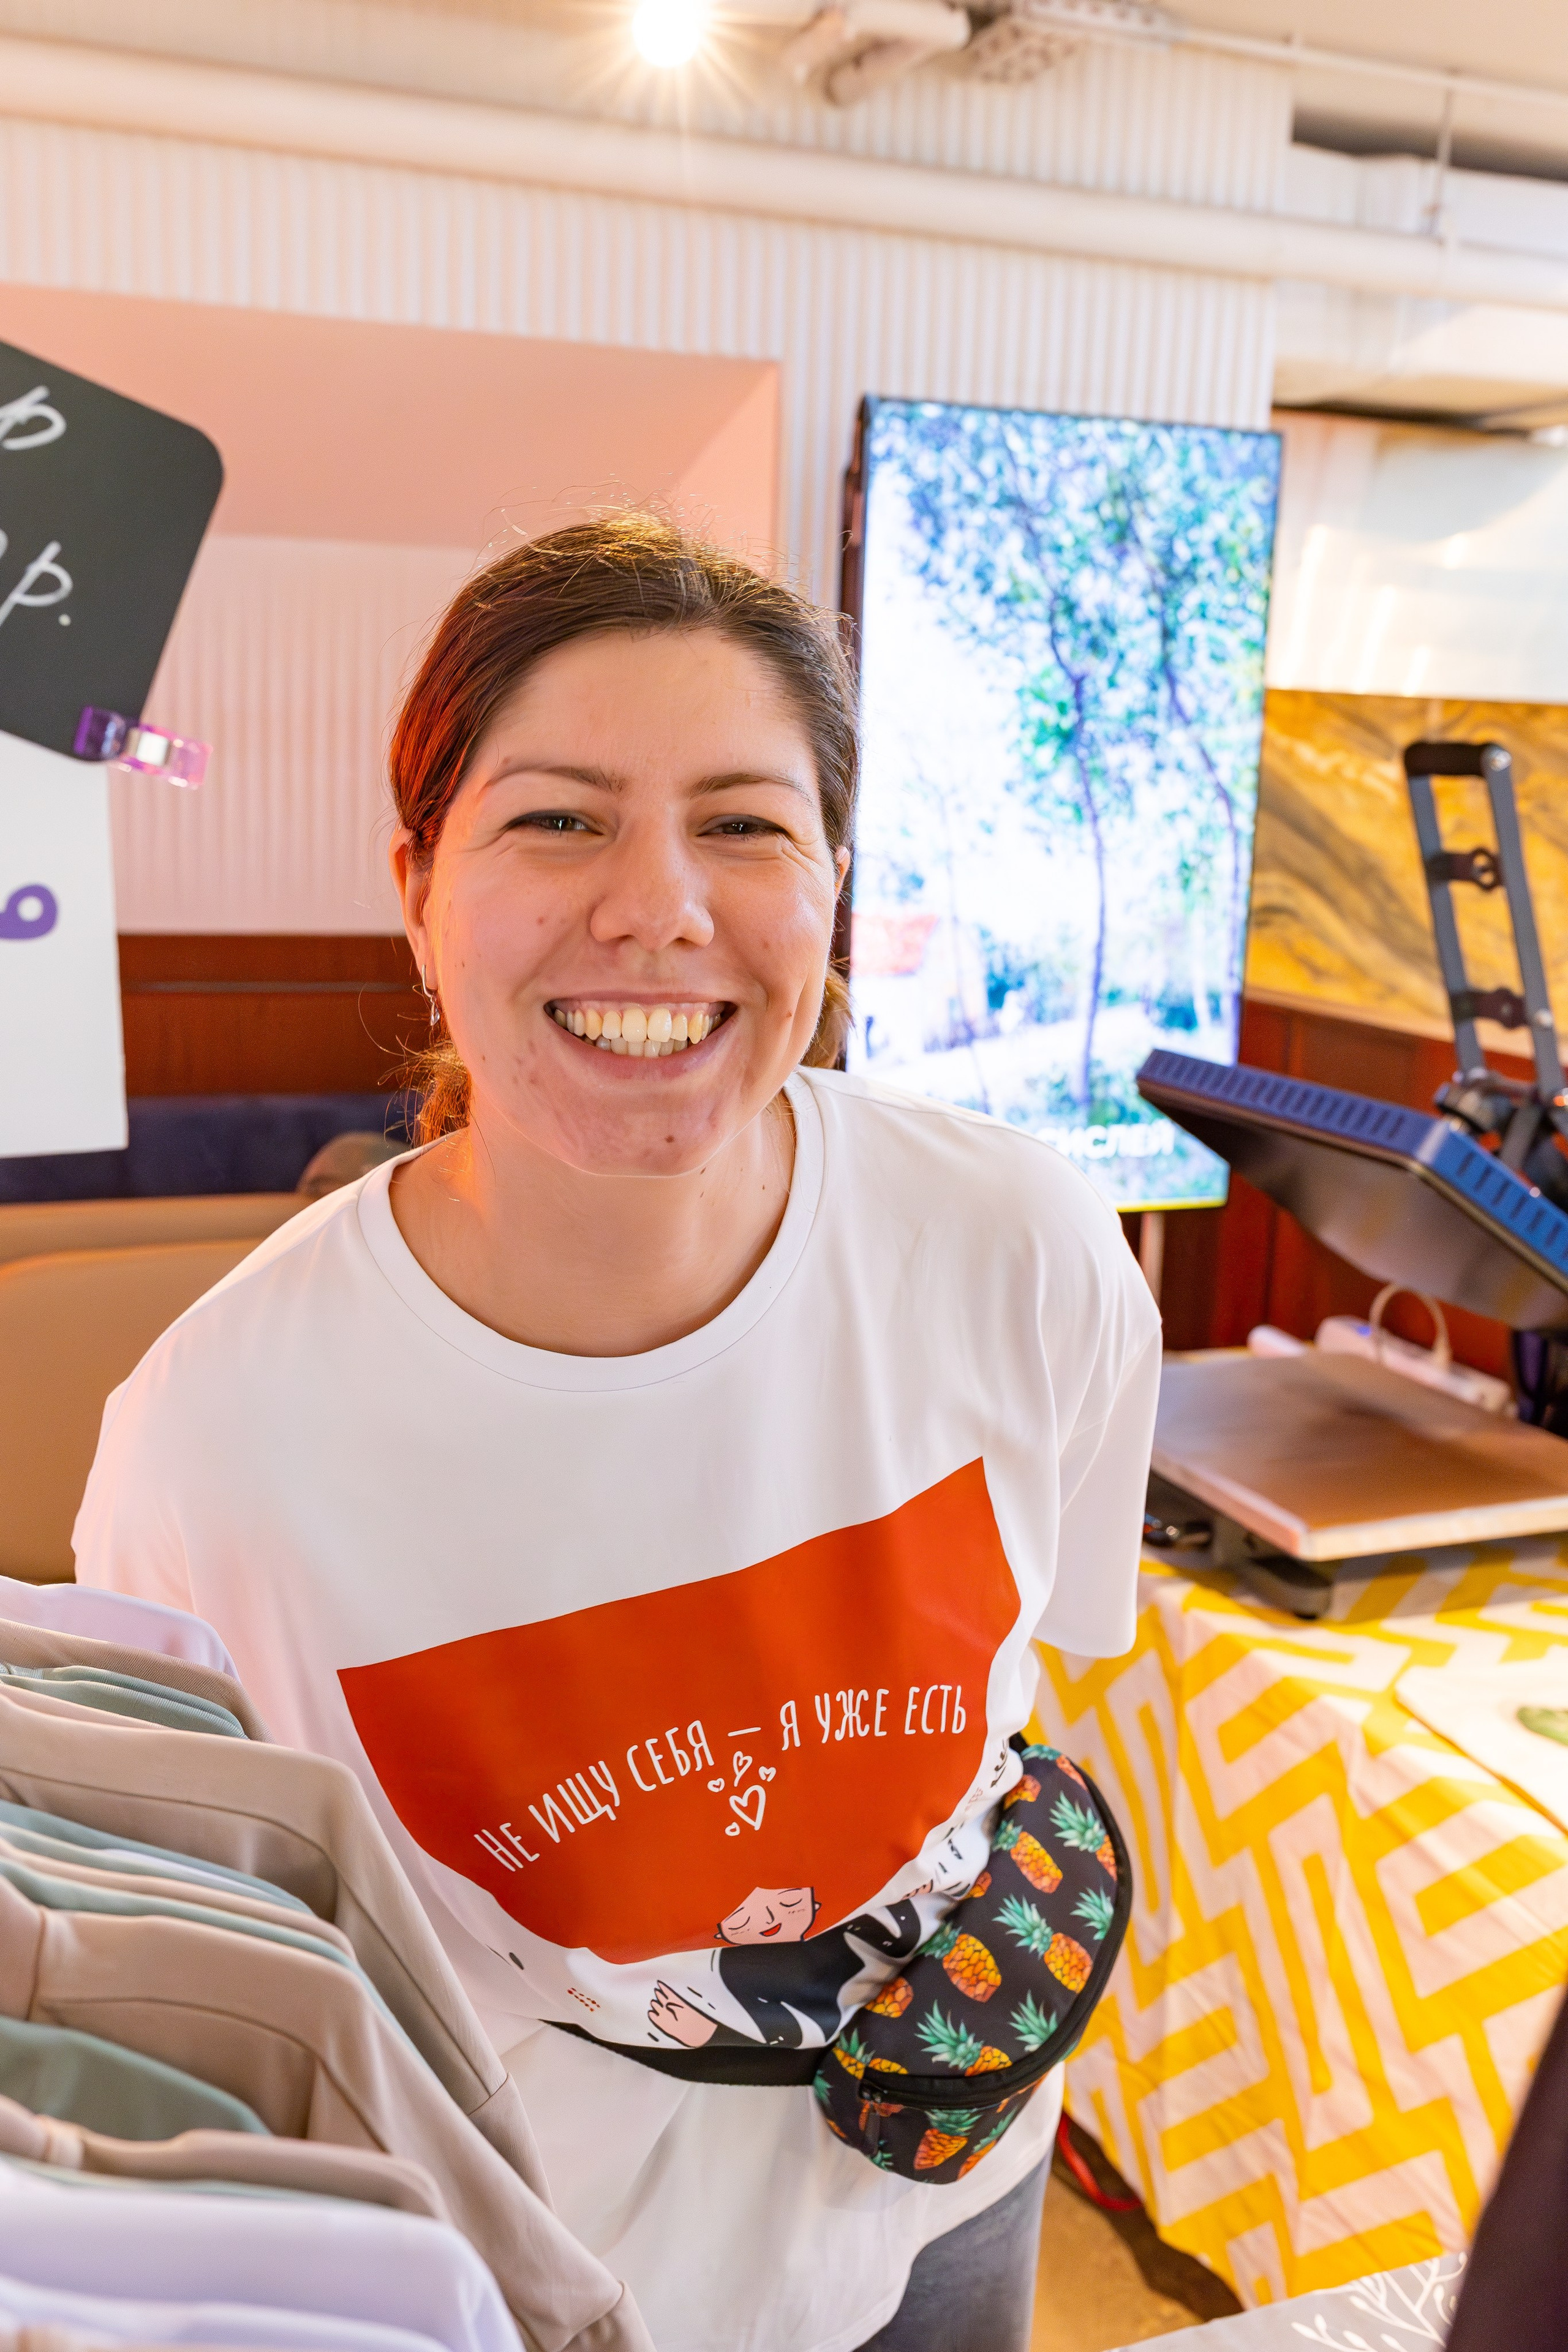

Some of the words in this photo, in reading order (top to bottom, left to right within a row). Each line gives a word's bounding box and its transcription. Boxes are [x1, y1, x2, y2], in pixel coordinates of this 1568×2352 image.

[474, 1822, 540, 1872] НЕ
[528, 1760, 620, 1845] ИЩУ
[627, 1720, 715, 1792] СЕБЯ
[780, 1700, 801, 1751] Я
[814, 1688, 889, 1744] УЖЕ
[904, 1684, 967, 1735] ЕСТЬ
